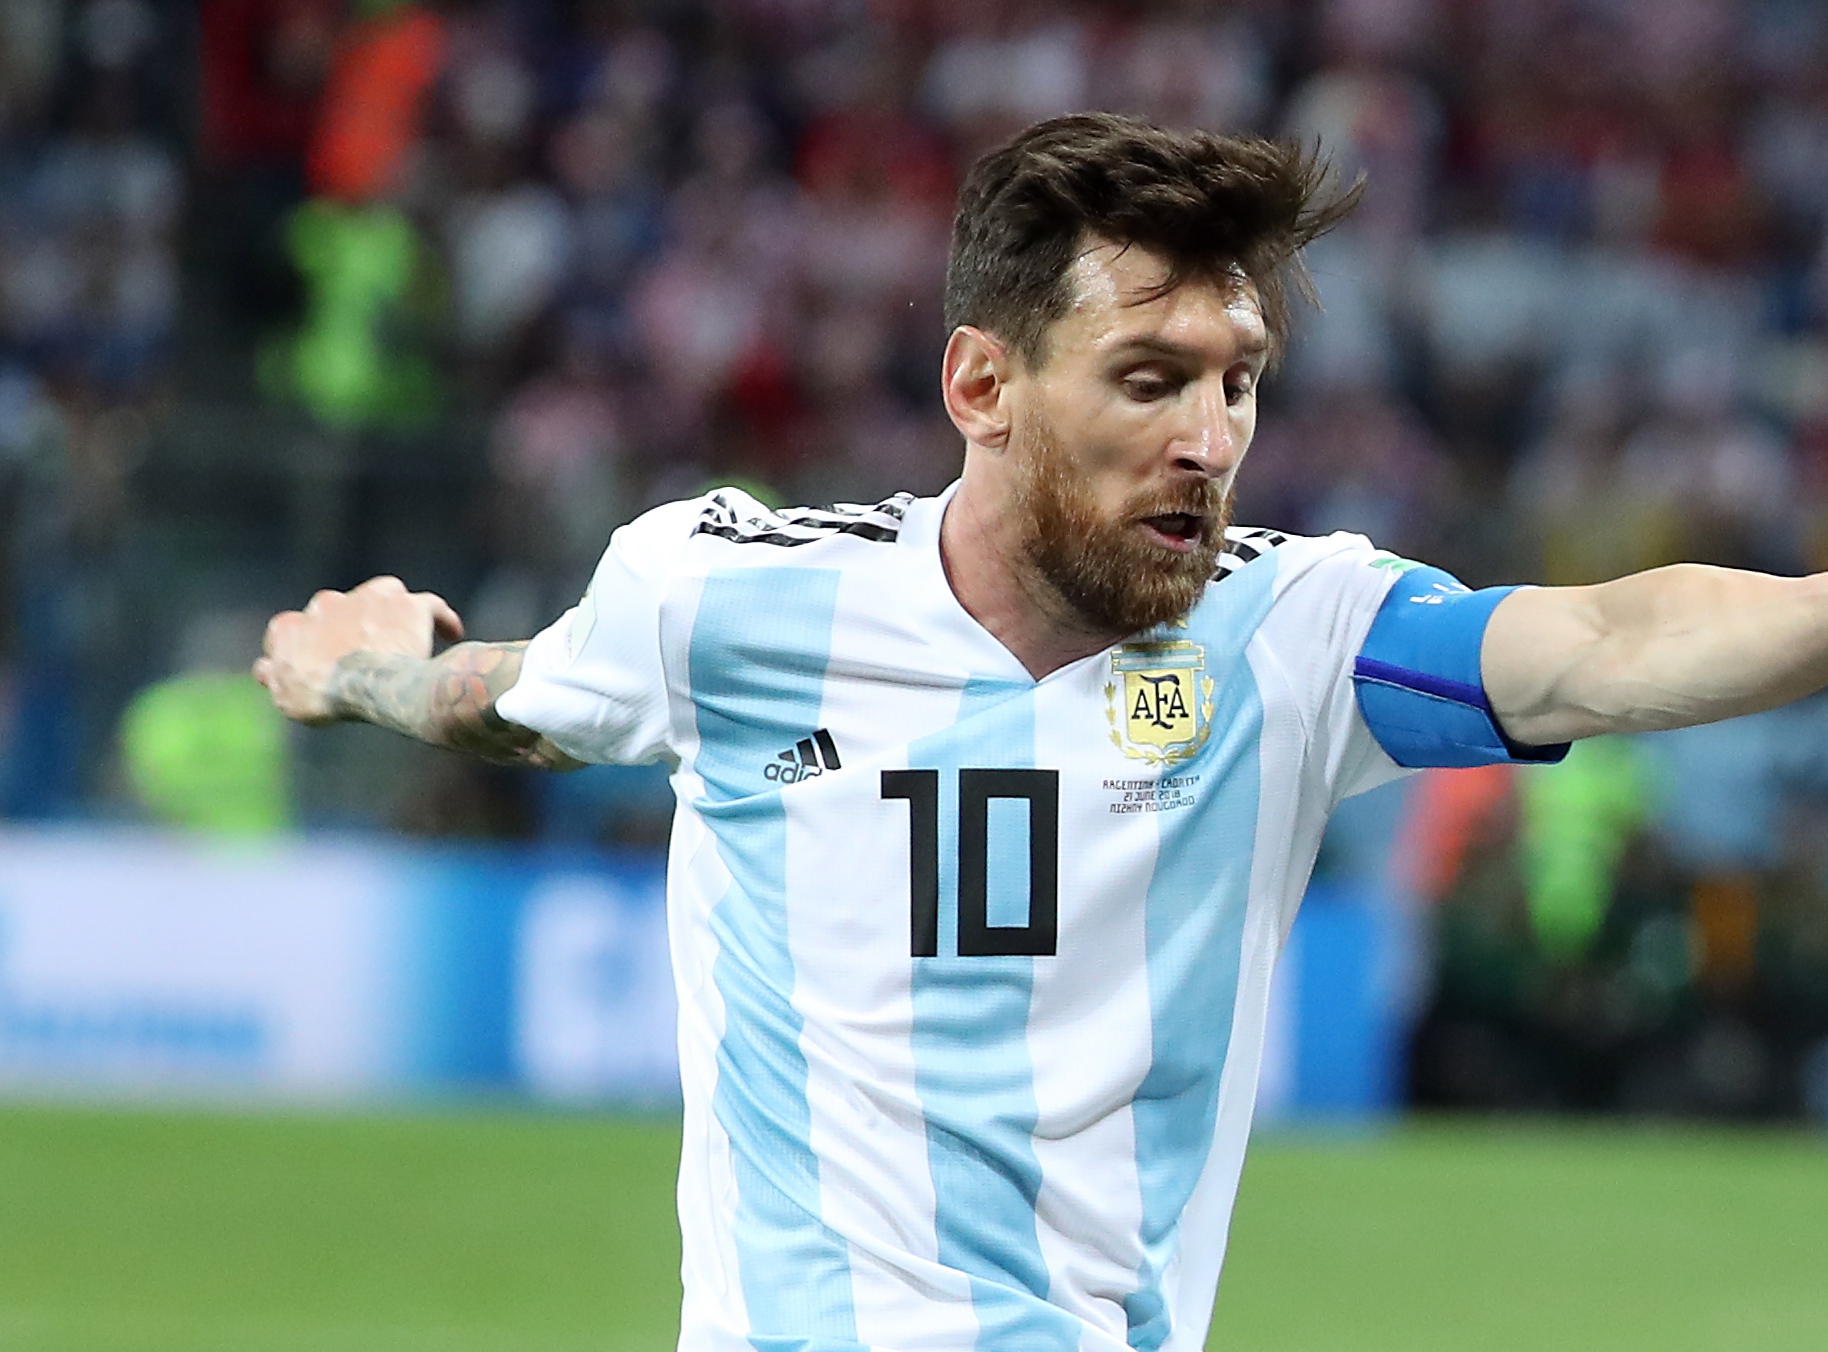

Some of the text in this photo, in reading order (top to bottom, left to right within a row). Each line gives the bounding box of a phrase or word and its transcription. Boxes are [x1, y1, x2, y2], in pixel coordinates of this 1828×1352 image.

[1131, 673, 1190, 730] AFA
[1102, 779, 1154, 790] ARGENTINA
[1123, 789, 1181, 803] 21 JUNE 2018
[880, 768, 1060, 958] 10
